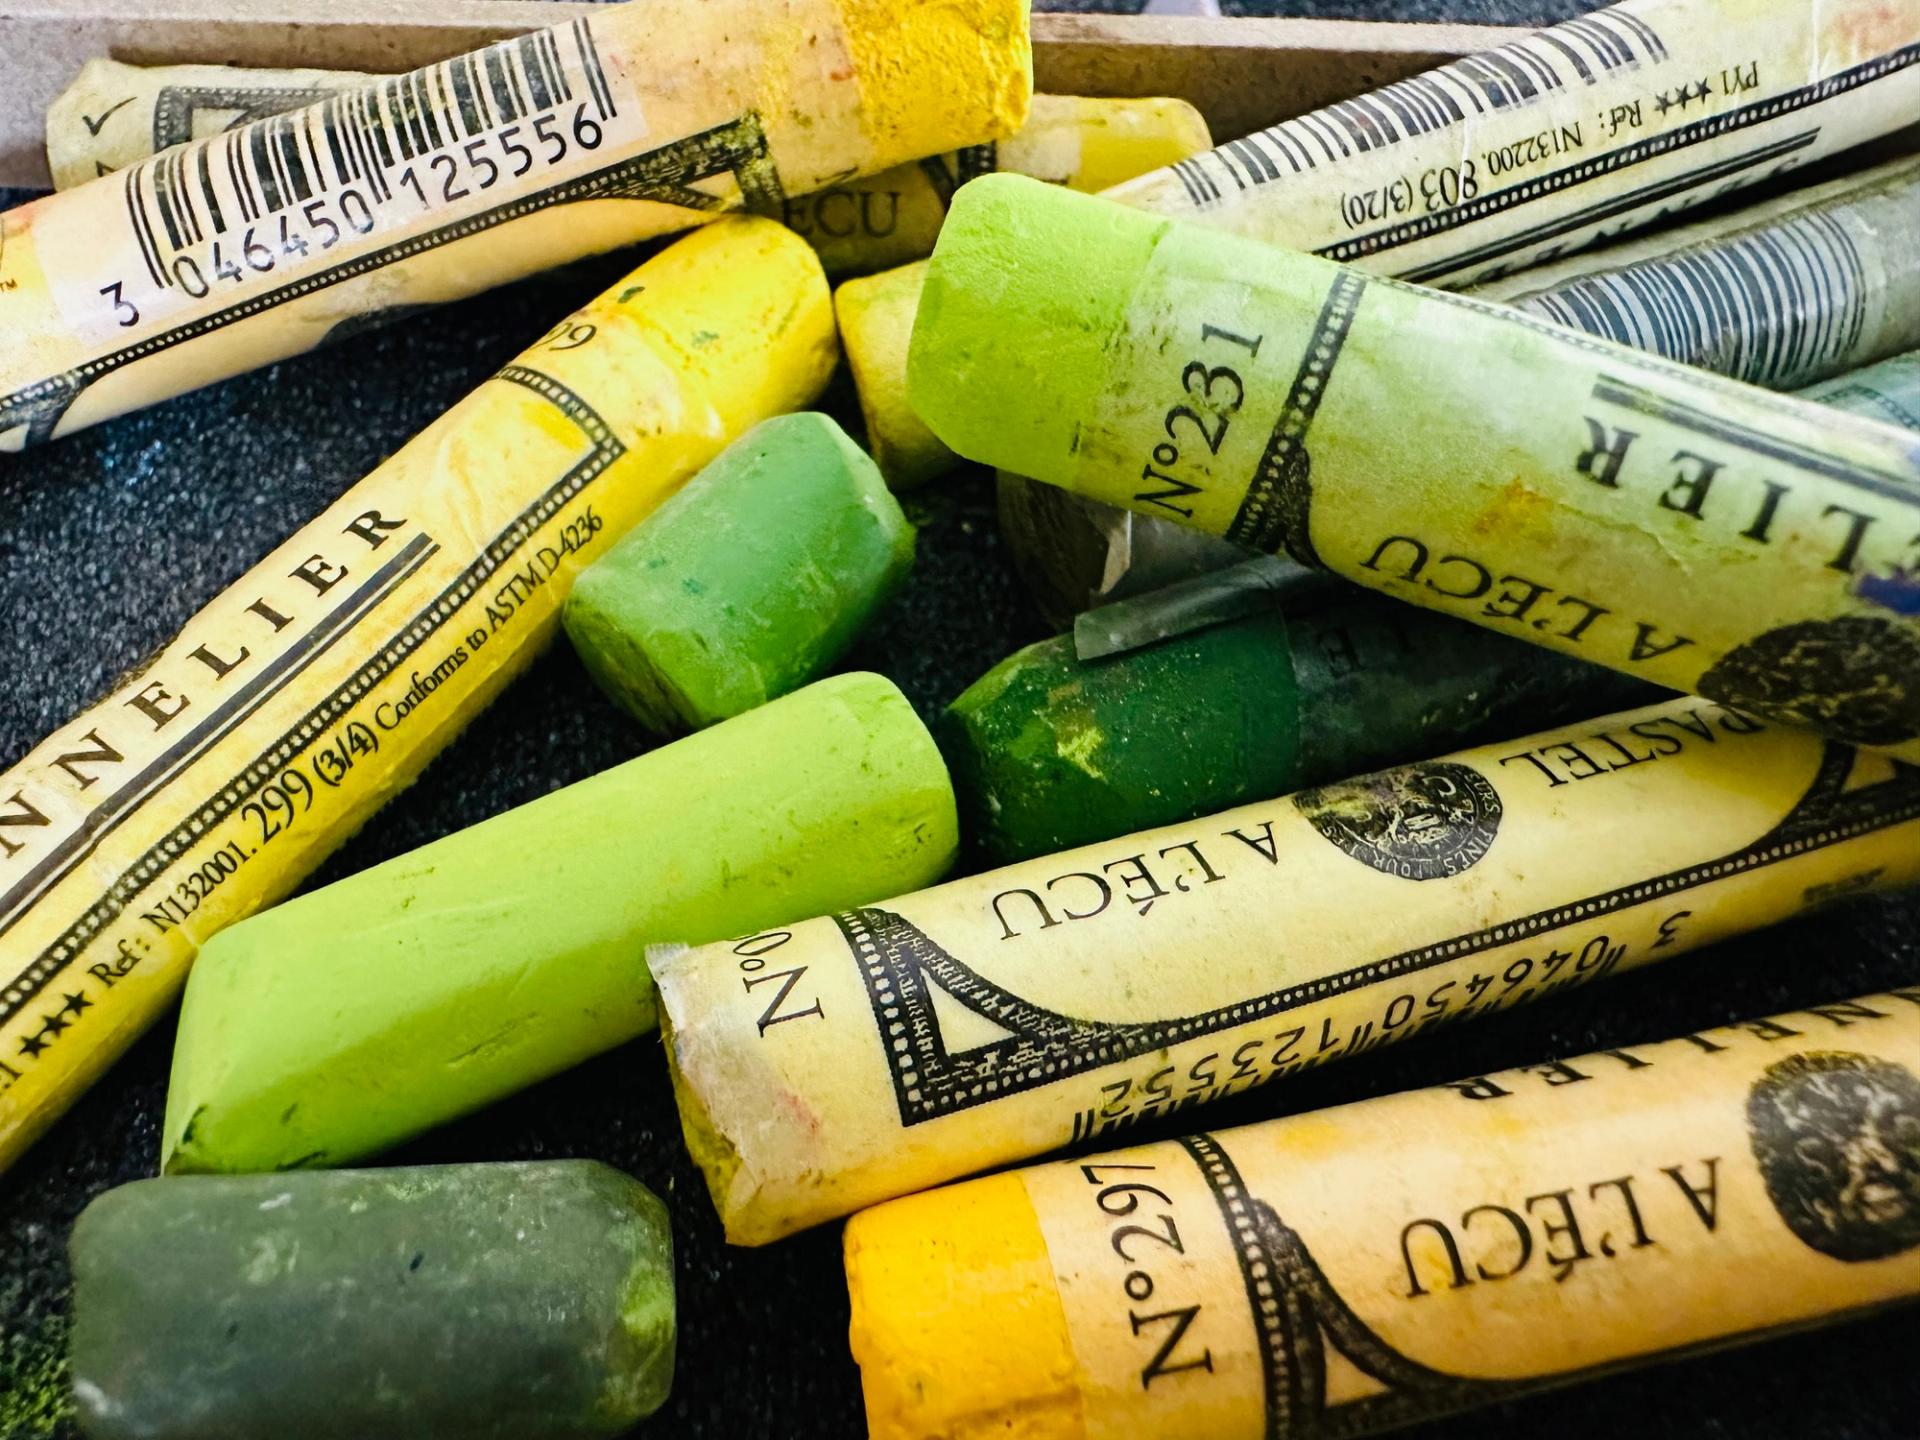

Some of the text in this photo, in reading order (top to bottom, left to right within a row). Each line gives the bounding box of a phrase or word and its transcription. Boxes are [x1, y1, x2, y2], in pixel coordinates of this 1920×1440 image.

[100, 102, 602, 327] 3 046450 125556
[1576, 415, 1920, 576] LIER
[240, 768, 314, 845] 299
[312, 720, 380, 788] (3/4)
[374, 645, 470, 731] Conforms
[465, 628, 489, 652] to
[485, 560, 546, 634] ASTM
[1219, 819, 1280, 867] A
[1499, 703, 1768, 788] PASTEL
[1100, 909, 1693, 1120] 3 046450 123552
[1657, 1155, 1722, 1233] A
